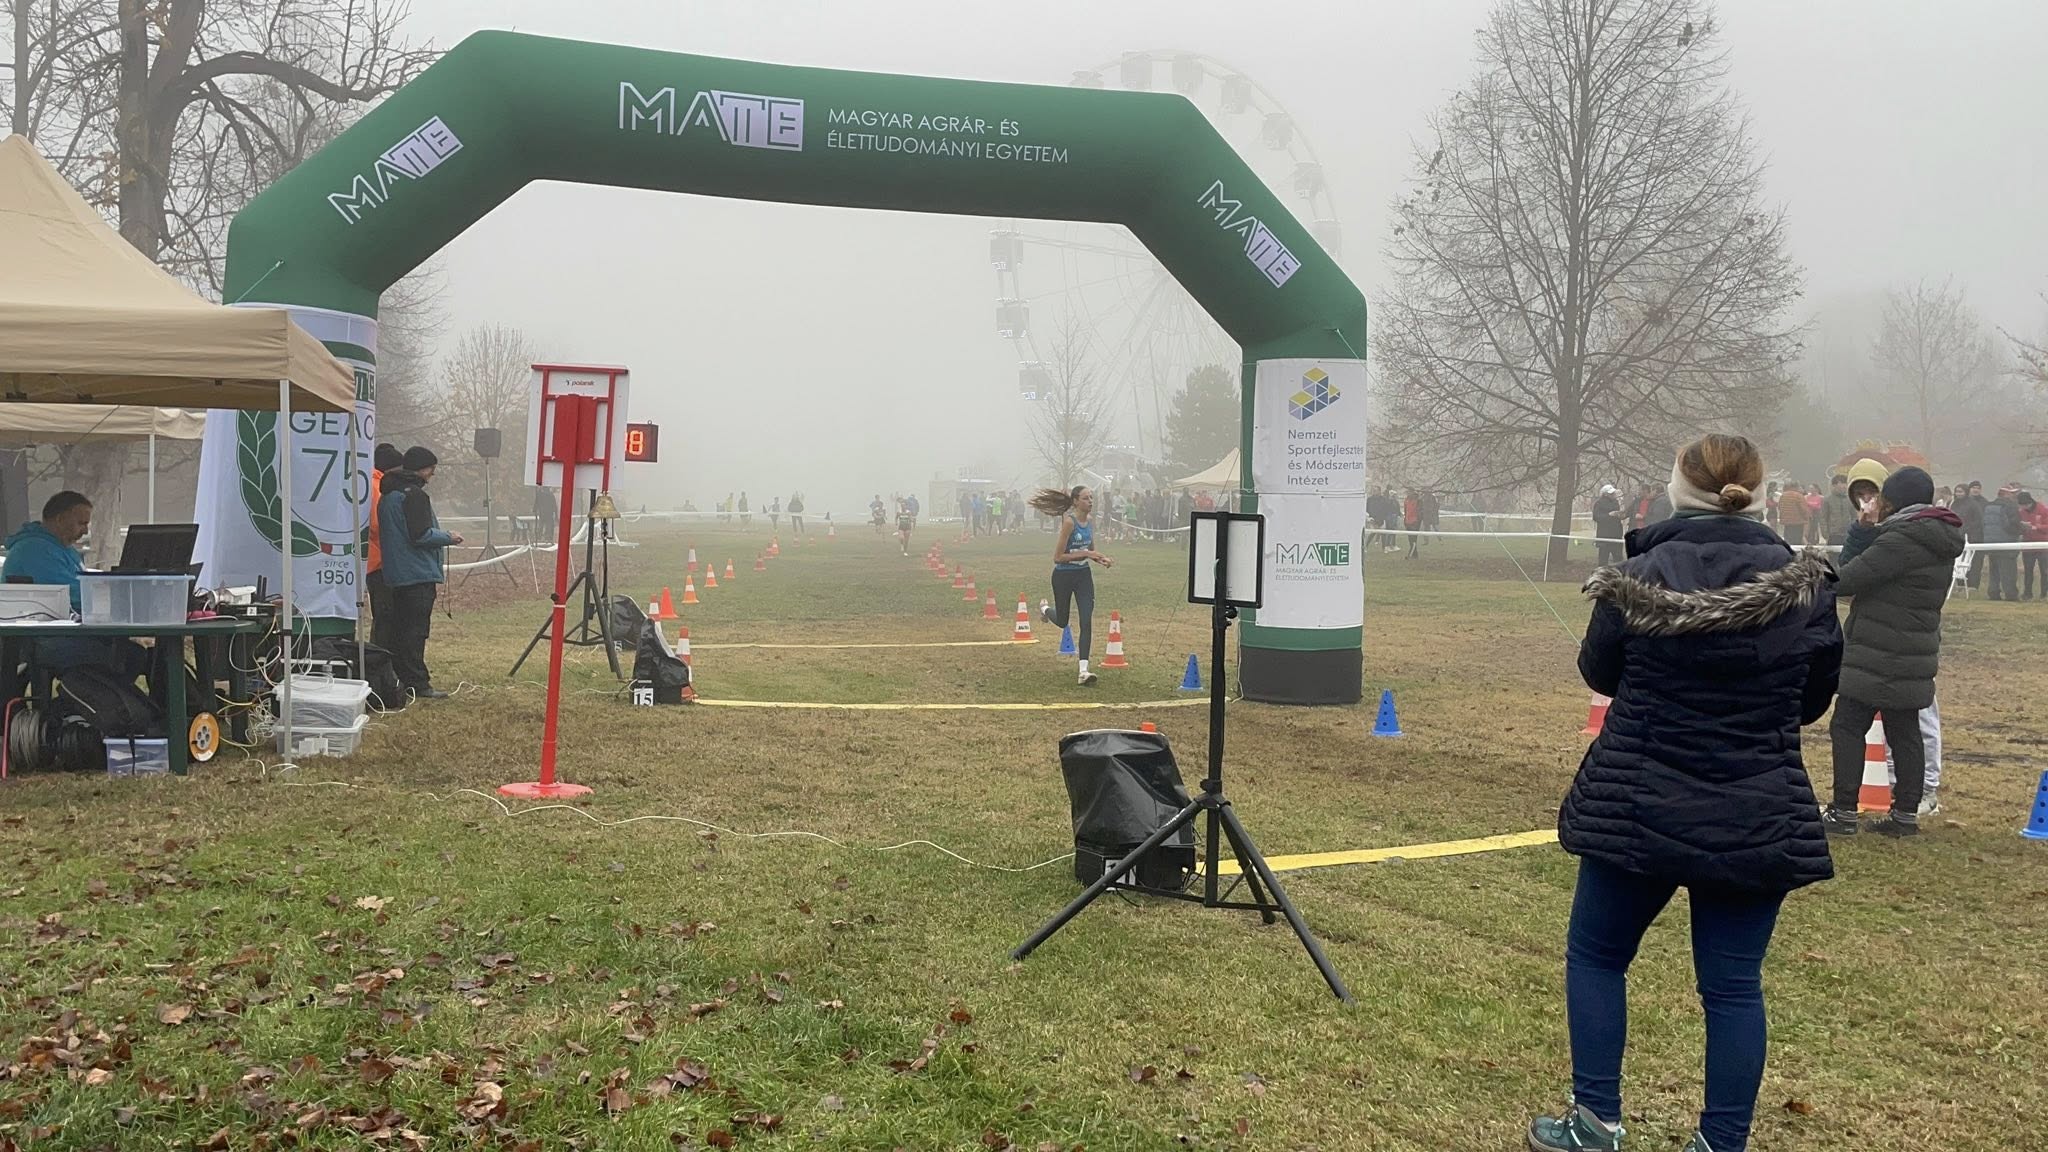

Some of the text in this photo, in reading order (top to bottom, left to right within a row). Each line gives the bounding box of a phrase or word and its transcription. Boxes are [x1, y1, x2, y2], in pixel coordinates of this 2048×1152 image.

[619, 82, 804, 151] MATE
[828, 108, 1020, 137] MAGYAR AGRÁR- ÉS
[827, 130, 1069, 164] ÉLETTUDOMÁNYI EGYETEM
[327, 115, 464, 225] MATE
[1197, 179, 1302, 288] MATE
[1288, 429, 1337, 440] Nemzeti
[302, 448, 370, 505] 75
[1288, 460, 1302, 470] és
[1287, 475, 1329, 486] Intézet
[1276, 542, 1350, 566] MATE
[316, 569, 355, 586] 1950
[635, 693, 653, 705] 15
